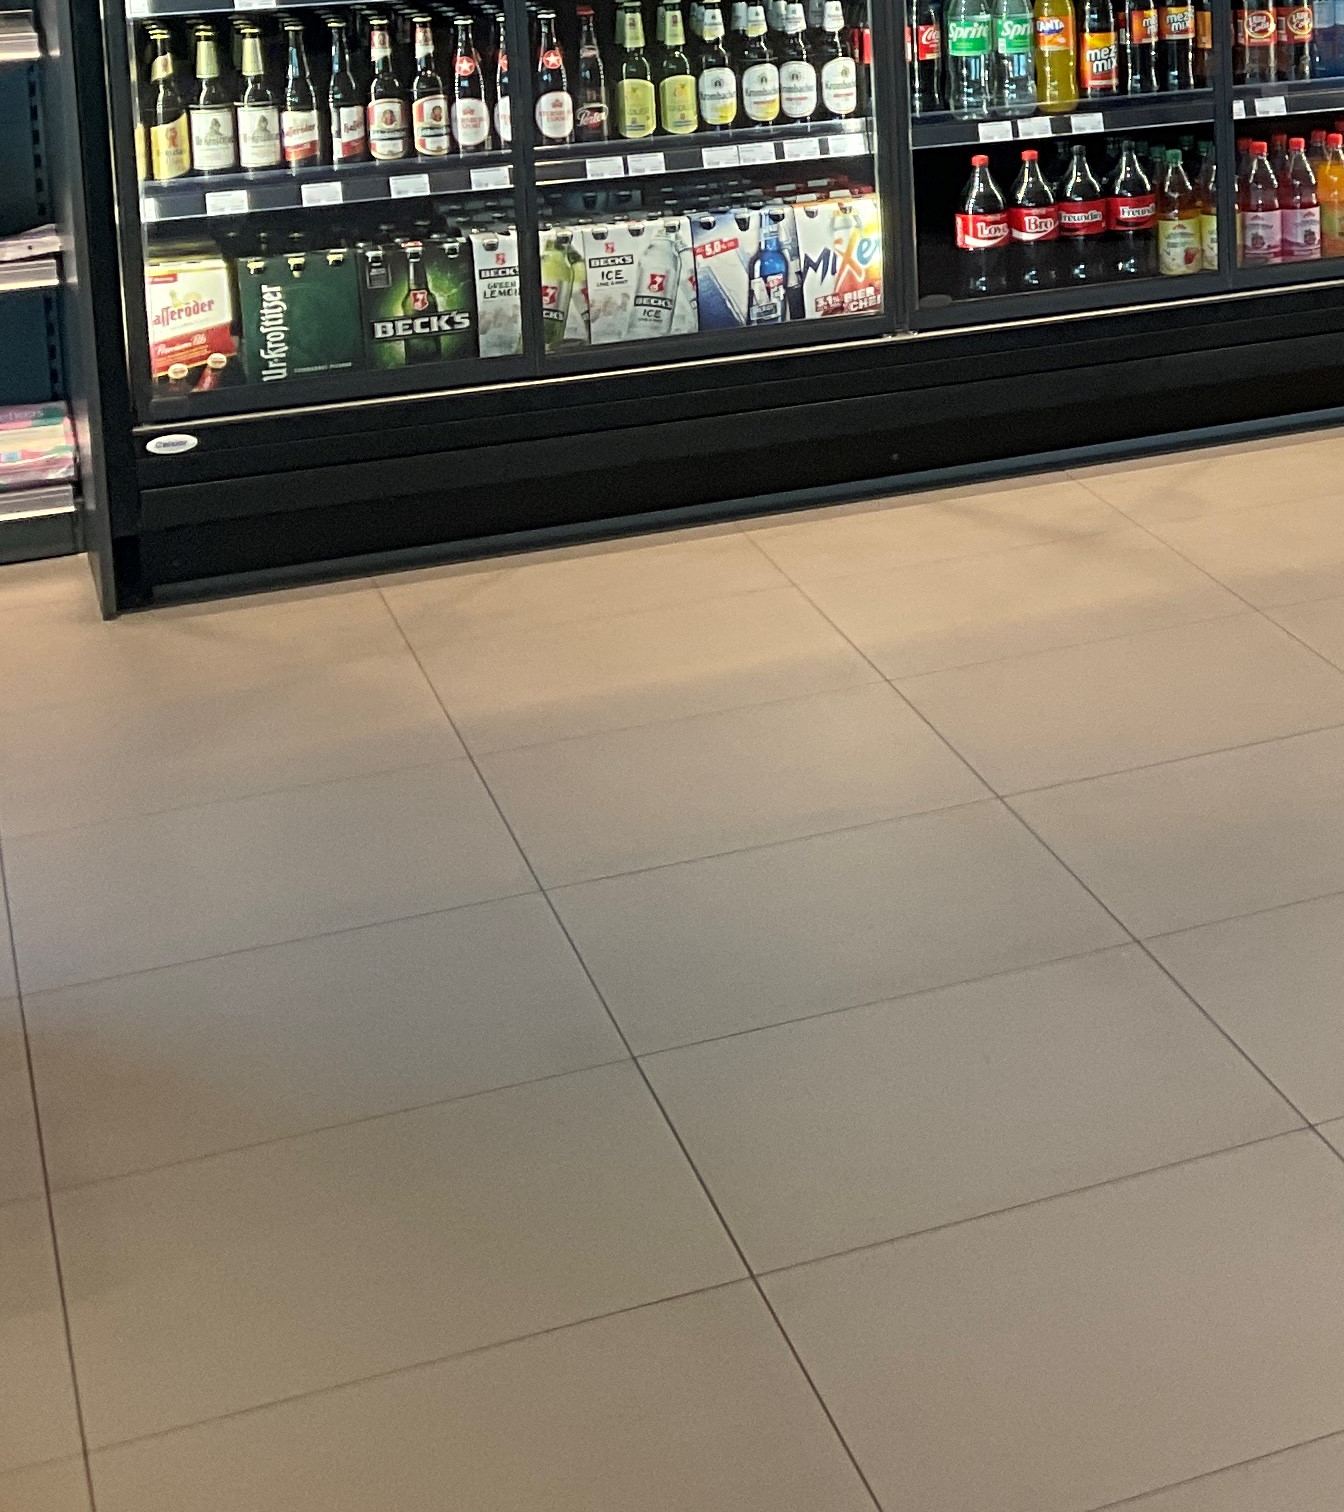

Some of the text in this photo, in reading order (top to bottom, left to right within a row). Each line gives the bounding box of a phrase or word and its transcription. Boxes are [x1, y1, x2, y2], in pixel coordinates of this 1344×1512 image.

[1091, 59, 1117, 74] mix
[1023, 216, 1054, 232] Bro
[588, 254, 634, 268] BECK'S
[601, 269, 624, 281] ICE
[642, 308, 661, 319] ICE
[372, 311, 470, 340] BECK'S
